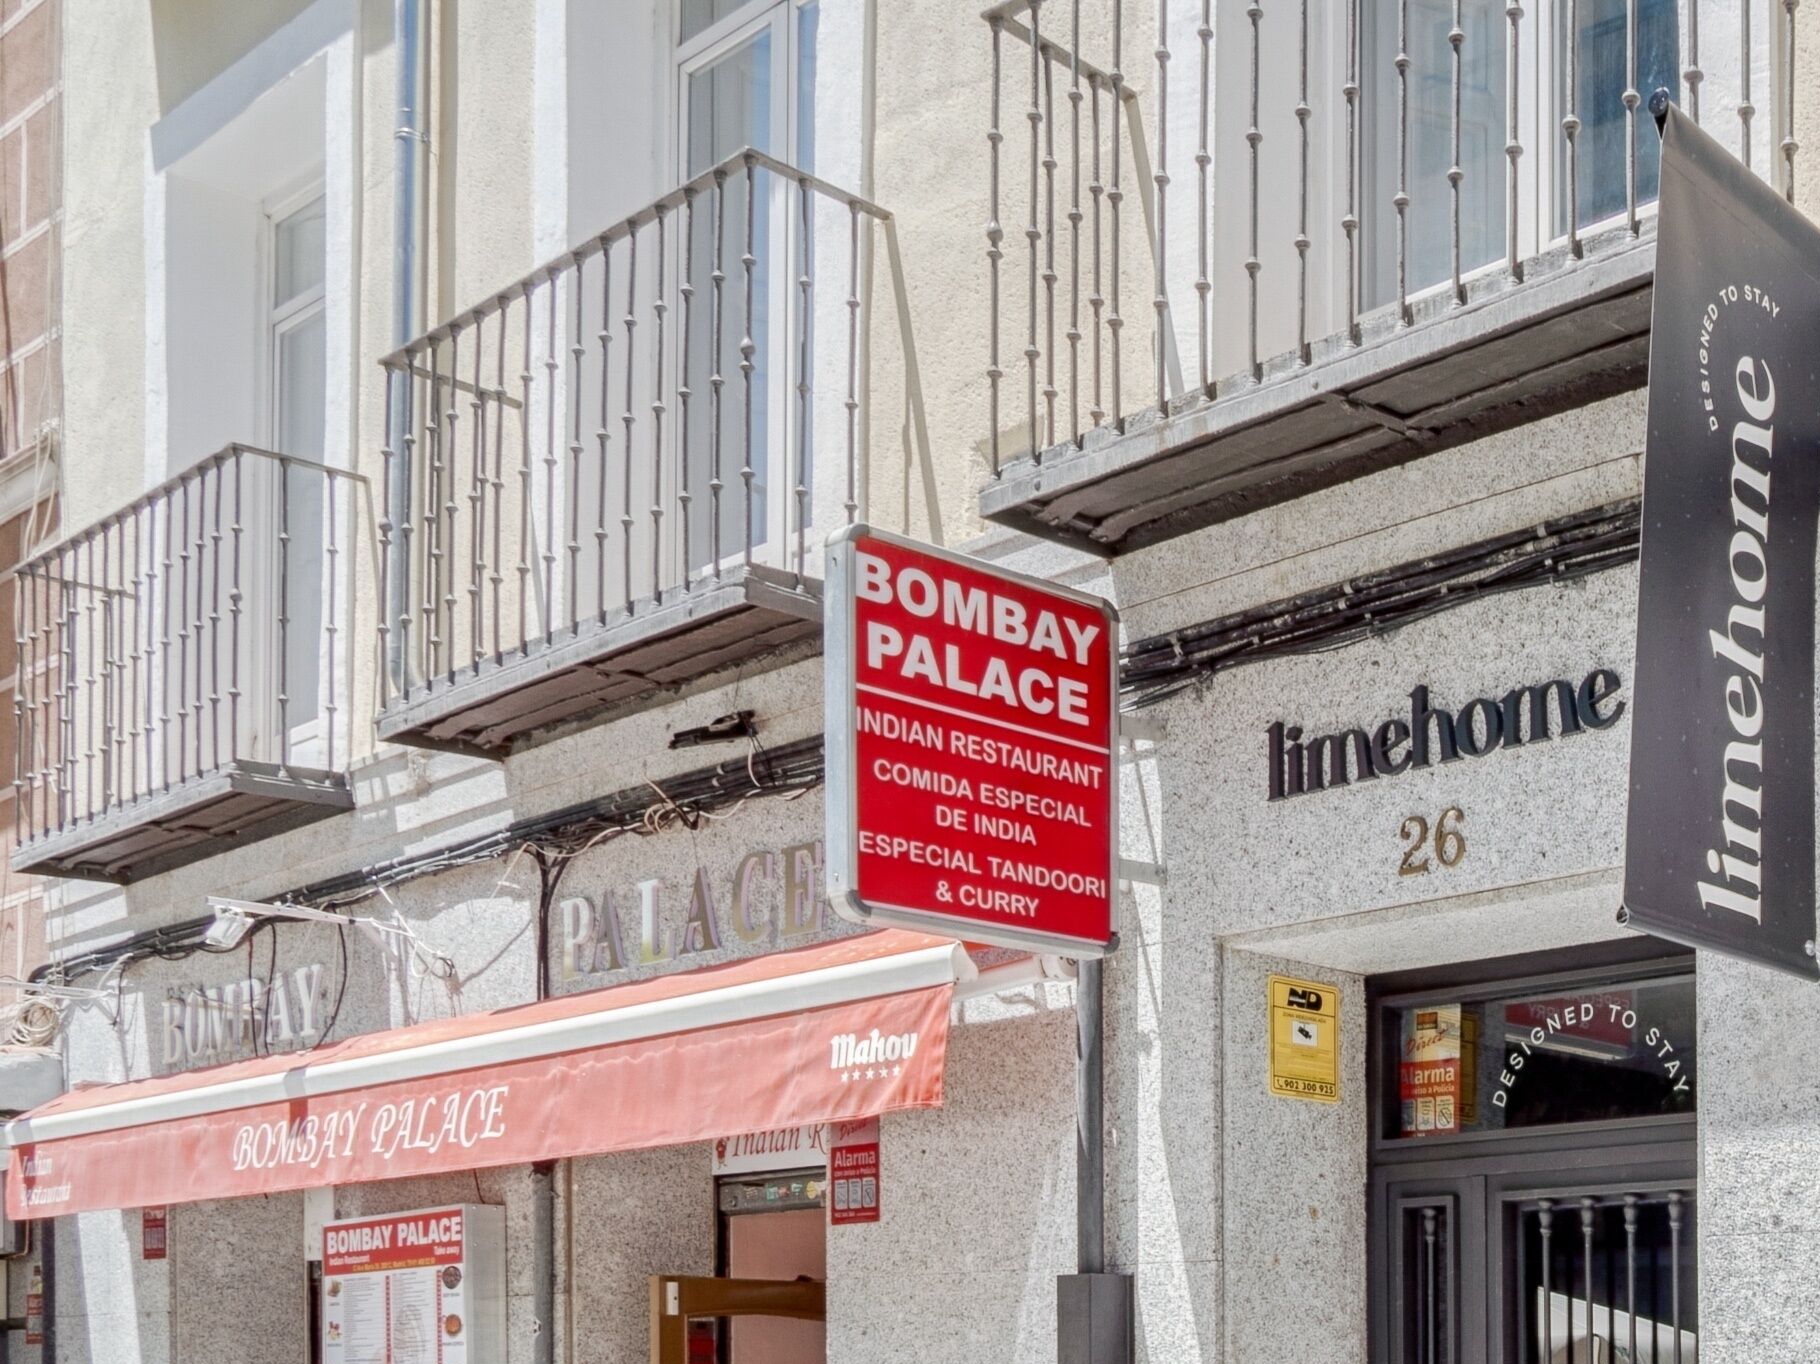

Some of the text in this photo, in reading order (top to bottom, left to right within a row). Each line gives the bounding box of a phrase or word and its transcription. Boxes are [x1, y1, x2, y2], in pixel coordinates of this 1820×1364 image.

[1699, 284, 1780, 432] DESIGNED TO STAY
[856, 550, 1100, 667] BOMBAY
[1696, 356, 1776, 927] limehome
[867, 620, 1090, 726] PALACE
[856, 706, 1103, 790] INDIAN RESTAURANT
[1265, 668, 1627, 802] limehome
[873, 758, 1092, 828] COMIDA ESPECIAL
[935, 804, 1037, 847] DE INDIA
[858, 830, 1107, 899] ESPECIAL TANDOORI
[1398, 806, 1467, 876] 26
[559, 840, 824, 983] PALACE
[935, 879, 1040, 918] & CURRY
[830, 1028, 918, 1070] Mahou
[1492, 1003, 1690, 1108] DESIGNED TO STAY
[232, 1085, 509, 1171] BOMBAY PALACE
[833, 1149, 876, 1169] Alarma
[326, 1215, 462, 1255] BOMBAY PALACE
